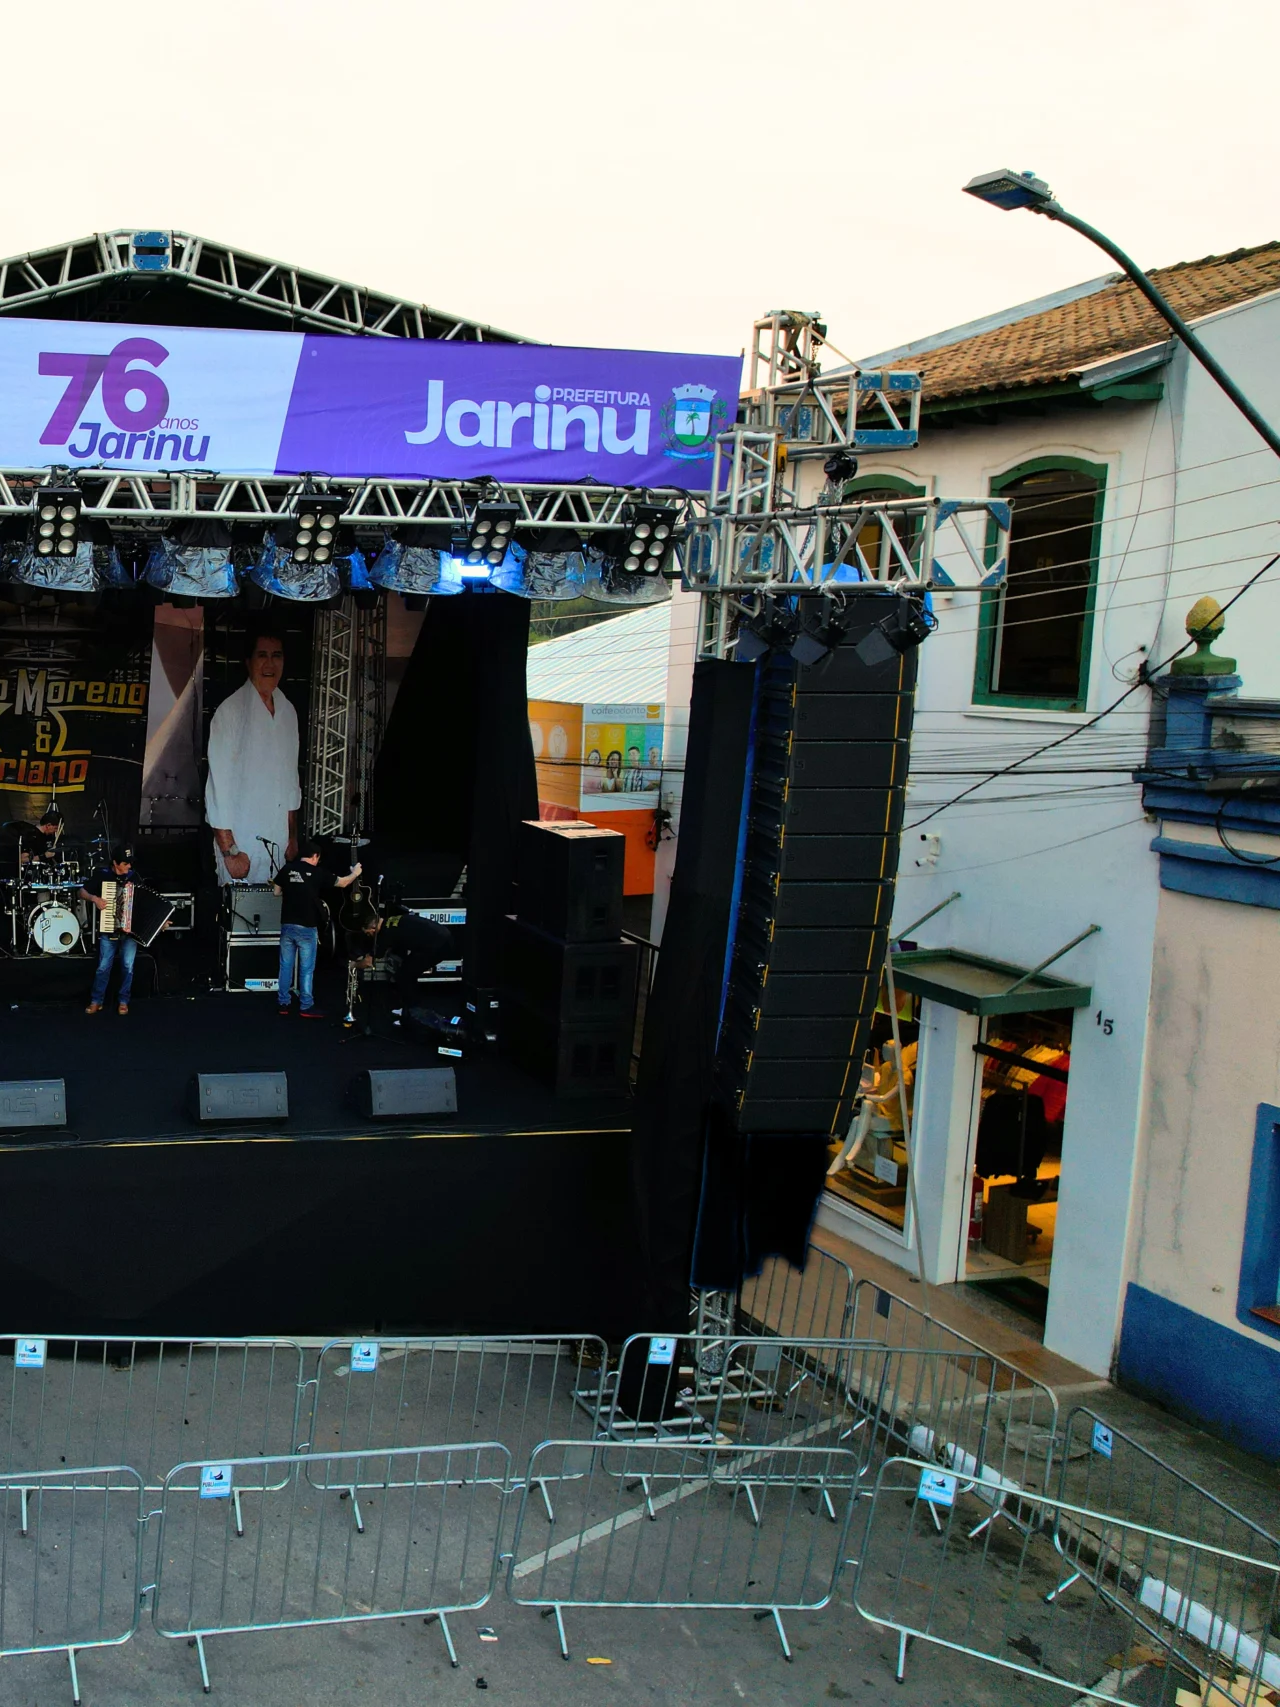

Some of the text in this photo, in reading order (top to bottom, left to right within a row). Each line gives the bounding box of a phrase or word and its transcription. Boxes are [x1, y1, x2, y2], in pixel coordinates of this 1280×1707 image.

[38, 337, 170, 445] 76
[552, 387, 652, 407] PREFEITURA
[158, 415, 200, 431] anos
[404, 379, 652, 456] Jarinu
[68, 422, 211, 462] Jarinu
[14, 669, 146, 716] Moreno
[35, 720, 52, 753] &
[1096, 1010, 1114, 1035] 15
